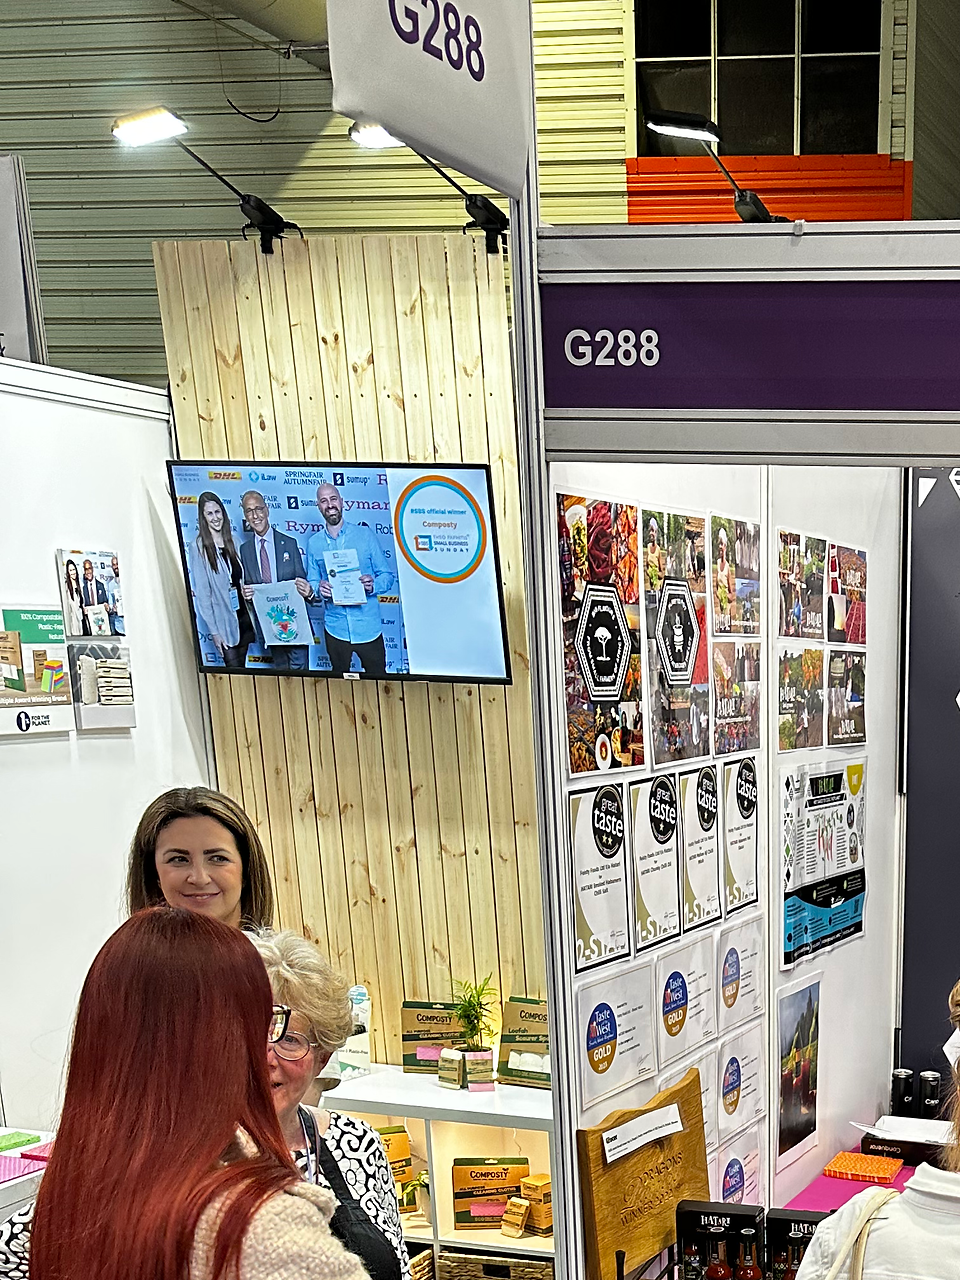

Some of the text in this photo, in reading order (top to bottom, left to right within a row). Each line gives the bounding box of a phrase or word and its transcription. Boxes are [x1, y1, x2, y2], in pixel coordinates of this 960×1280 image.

[389, 0, 485, 82] G288
[564, 329, 660, 366] G288
[213, 472, 241, 480] DHL
[422, 521, 458, 530] Composty
[14, 696, 30, 704] Award
[702, 778, 714, 792] great
[738, 777, 756, 802] taste
[656, 788, 671, 802] great
[698, 787, 717, 813] taste
[601, 798, 618, 813] great
[651, 796, 676, 824] taste
[594, 807, 623, 838] taste
[669, 977, 683, 989] Taste
[725, 983, 737, 997] GOLD
[670, 989, 683, 1002] West
[416, 1013, 453, 1023] COMPOSTY
[520, 1010, 548, 1022] COMPOS
[594, 1009, 611, 1023] Taste
[667, 1009, 683, 1025] GOLD
[595, 1023, 611, 1037] West
[593, 1044, 612, 1062] GOLD
[725, 1090, 738, 1105] GOLD
[470, 1171, 509, 1179] COMPOSTY
[728, 1164, 740, 1176] Taste
[620, 1201, 654, 1227] WINNER
[701, 1215, 731, 1227] HATARI
[791, 1222, 818, 1234] HATAR
